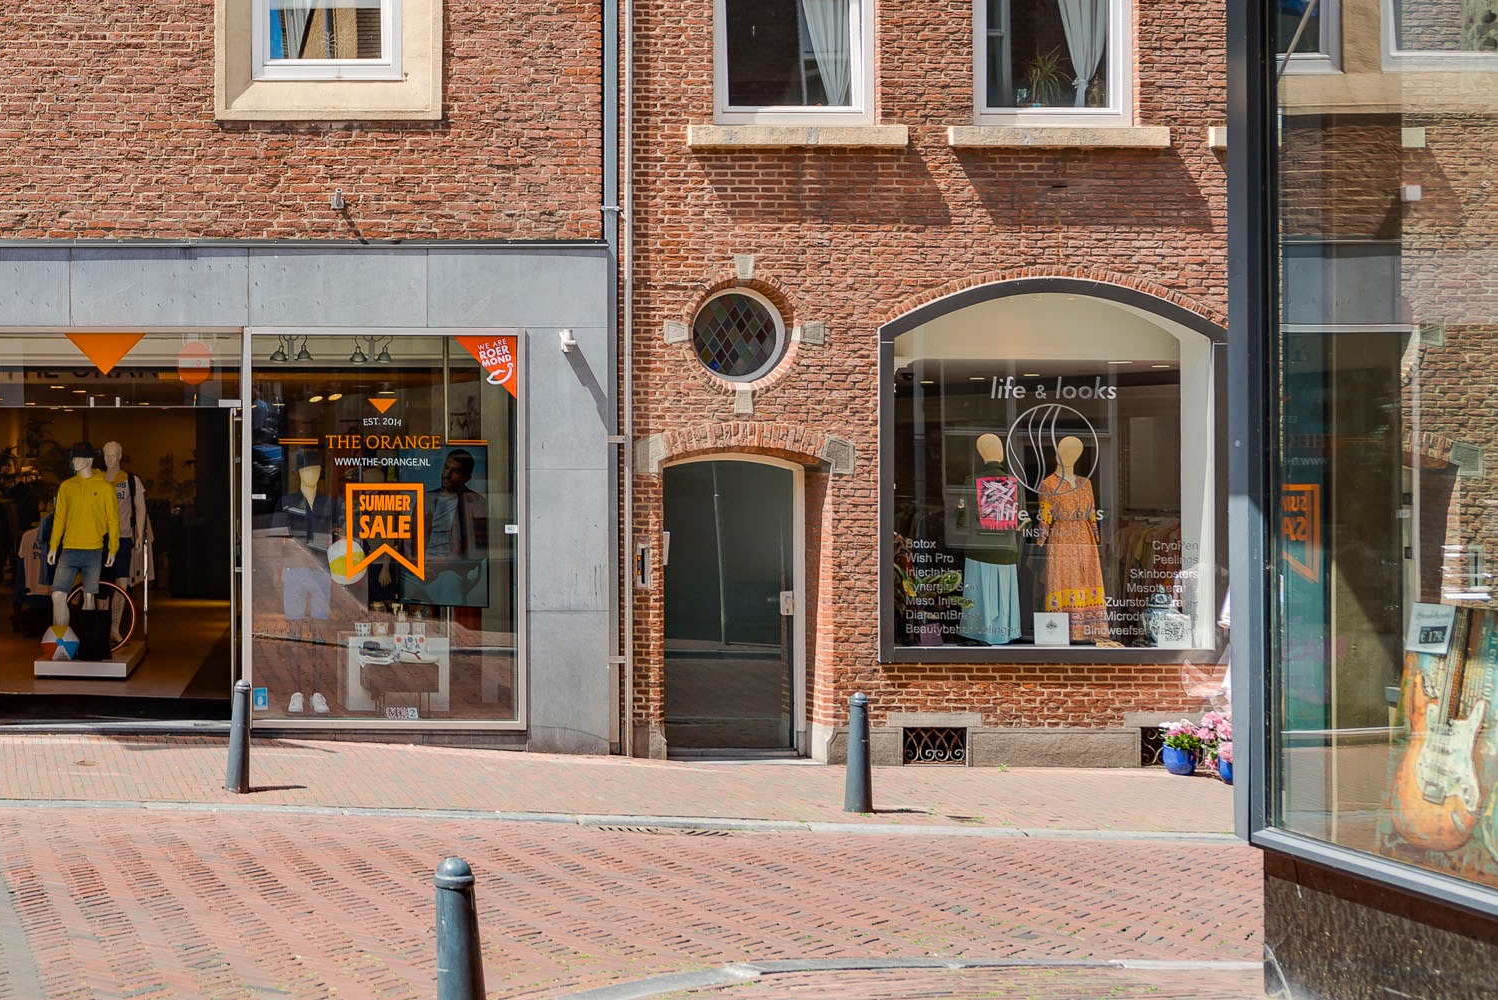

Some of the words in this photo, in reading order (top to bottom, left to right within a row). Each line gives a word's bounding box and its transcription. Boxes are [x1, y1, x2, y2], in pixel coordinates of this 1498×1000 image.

[478, 343, 490, 351] WE
[493, 338, 507, 348] ARE
[479, 345, 510, 360] ROER
[482, 354, 512, 367] MOND
[991, 376, 1026, 400] life
[1035, 385, 1047, 399] &
[1055, 376, 1117, 400] looks
[363, 418, 381, 426] EST.
[382, 418, 402, 427] 2014
[326, 435, 361, 449] THE
[366, 435, 442, 449] ORANGE
[335, 457, 431, 467] WWW.THE-ORANGE.NL
[359, 495, 411, 512] SUMMER
[1054, 502, 1104, 521] looks
[359, 515, 411, 539] SALE
[906, 539, 937, 549] Botox
[1152, 540, 1199, 552] CryoPen
[906, 553, 935, 563] Wish
[935, 553, 954, 563] Pro
[1153, 555, 1199, 566] Peelings
[1130, 569, 1199, 579] Skinboosters
[906, 596, 935, 606] Meso
